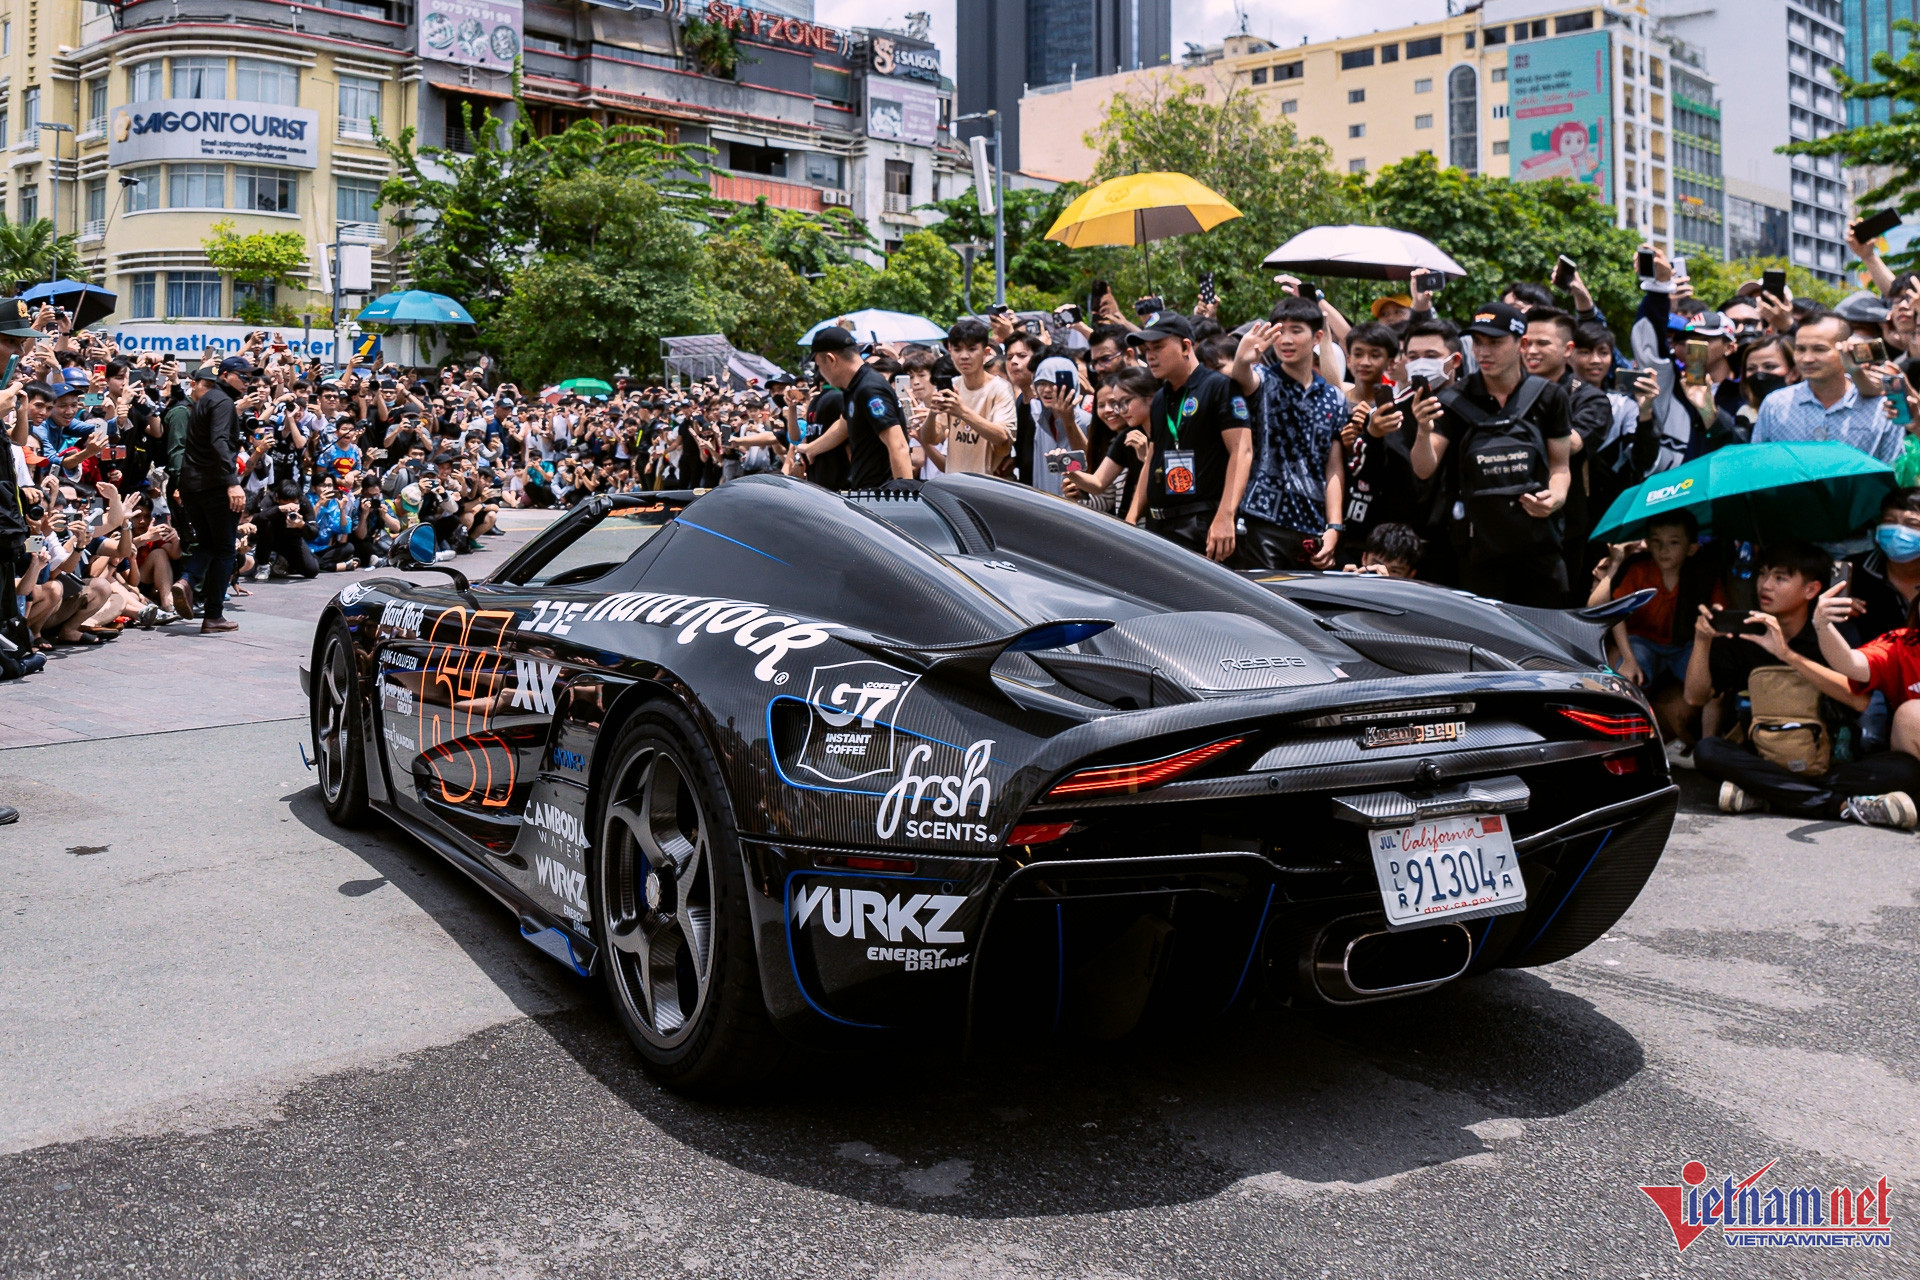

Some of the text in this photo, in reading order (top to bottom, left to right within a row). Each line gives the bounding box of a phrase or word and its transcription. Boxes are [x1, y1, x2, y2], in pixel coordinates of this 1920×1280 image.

[900, 50, 940, 73] SAIGON
[132, 111, 308, 140] SAIGONTOURIST
[1476, 450, 1529, 464] Panasonic
[1645, 483, 1682, 503] BIDV
[1219, 656, 1307, 672] Regera
[825, 733, 871, 744] INSTANT
[1365, 720, 1467, 747] Koenigsegg
[825, 745, 866, 756] COFFEE
[876, 739, 996, 839] frsh
[523, 799, 592, 849] CAMBODIA
[537, 829, 581, 864] WATER
[1379, 835, 1397, 850] JUL
[1401, 823, 1486, 853] California
[535, 853, 587, 912] WURKZ
[1405, 847, 1497, 906] 91304
[790, 883, 969, 944] WURKZ
[1423, 896, 1494, 915] dmv.ca.gov
[866, 946, 948, 962] ENERGY
[904, 952, 971, 971] DRINK
